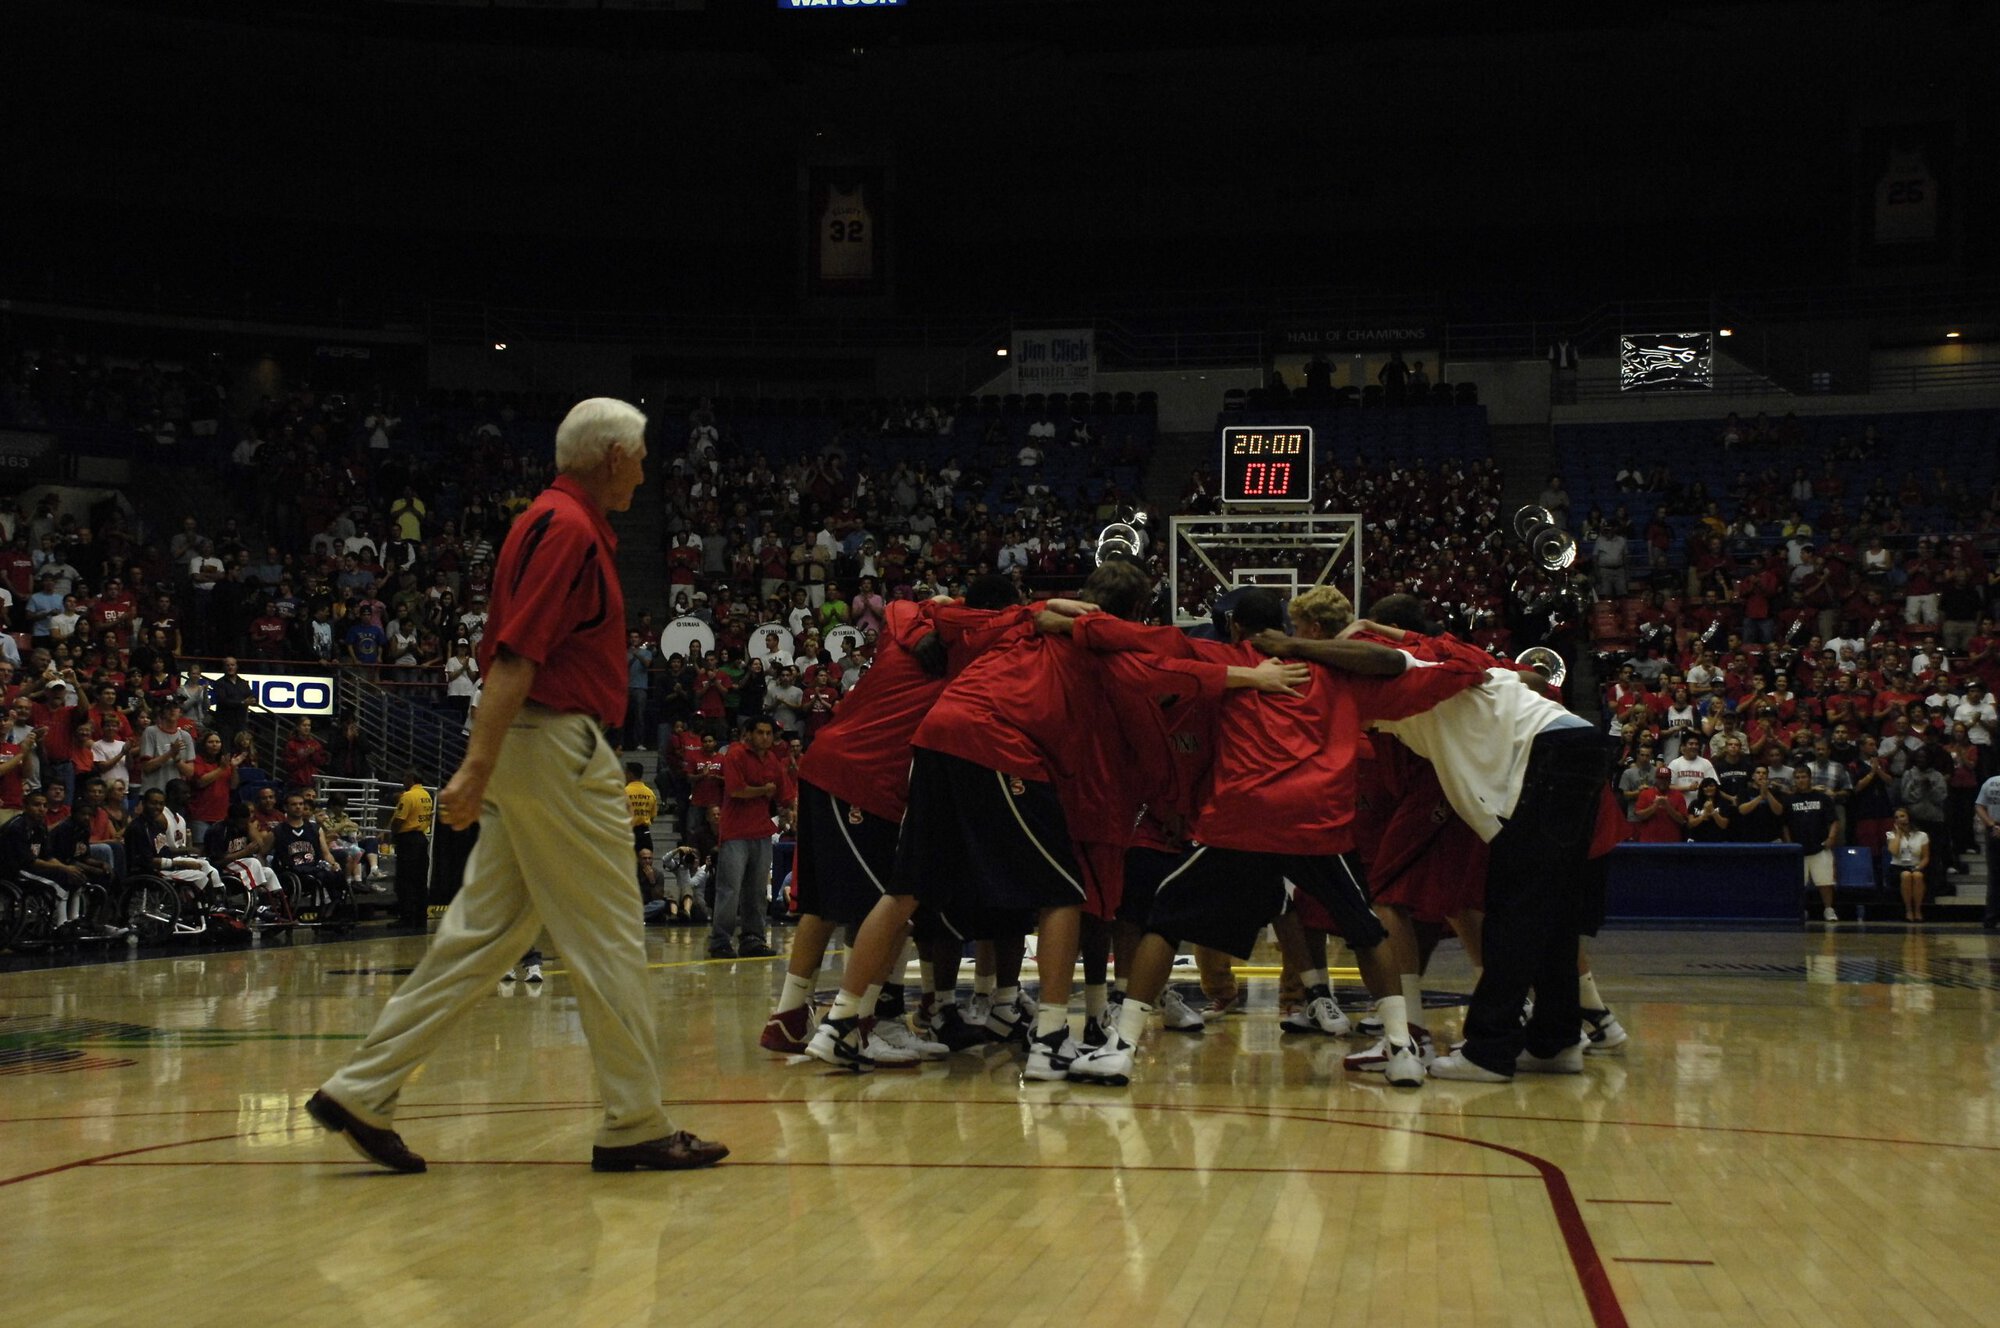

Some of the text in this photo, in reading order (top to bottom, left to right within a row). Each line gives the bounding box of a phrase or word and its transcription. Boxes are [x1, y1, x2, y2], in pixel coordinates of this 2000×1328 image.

[1889, 180, 1923, 204] 25
[830, 220, 863, 242] 32
[1287, 328, 1425, 342] HALL OF CHAMPIONS
[1018, 338, 1088, 362] Jim Click
[1233, 434, 1301, 454] 20:00
[1243, 462, 1291, 495] 00
